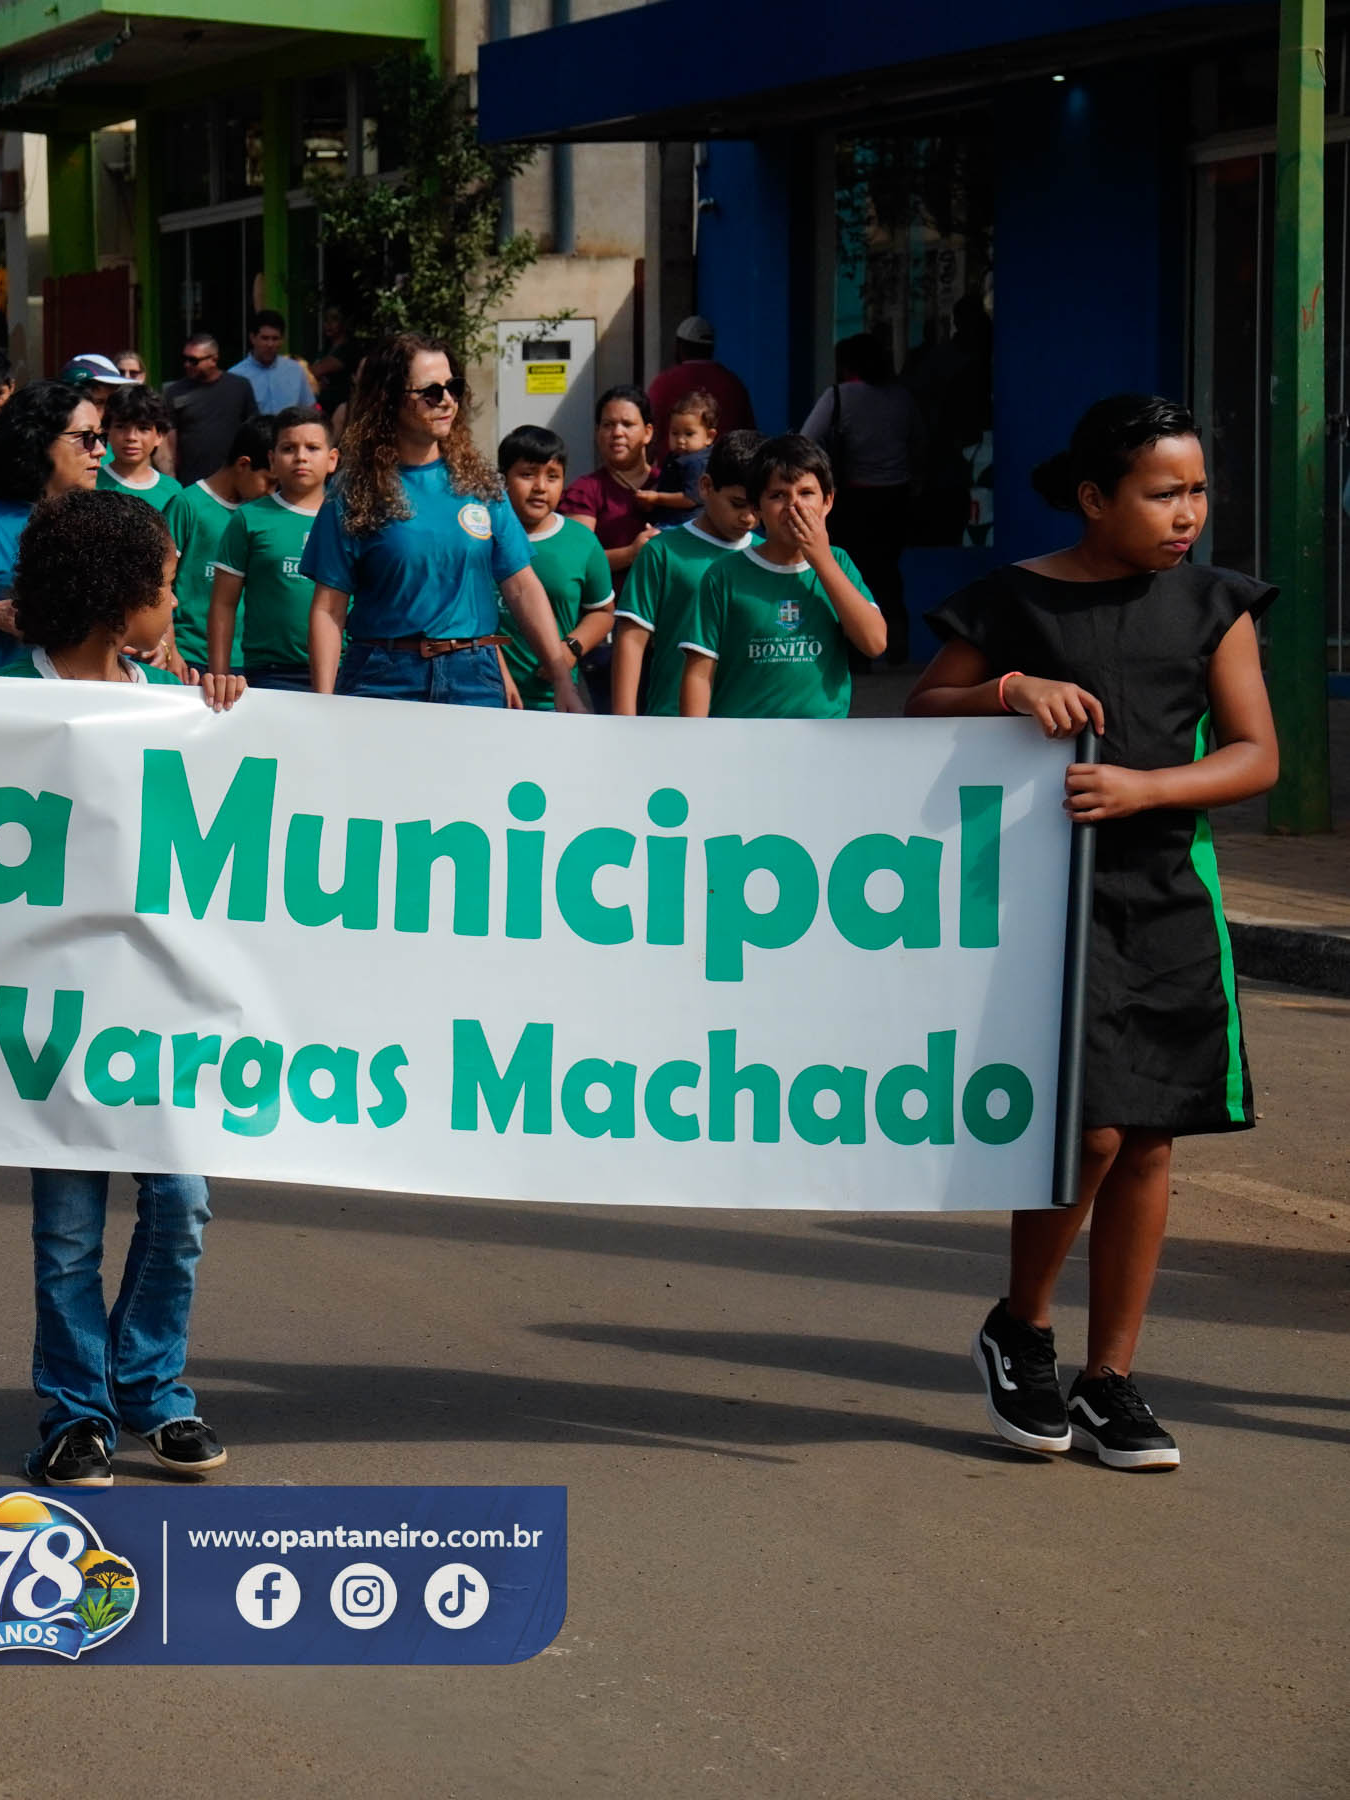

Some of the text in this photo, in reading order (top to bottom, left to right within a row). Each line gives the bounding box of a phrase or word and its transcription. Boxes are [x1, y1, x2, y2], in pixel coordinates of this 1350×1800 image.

[747, 640, 823, 659] BONITO
[134, 748, 1004, 983] Municipal
[450, 1019, 1035, 1146] Machado
